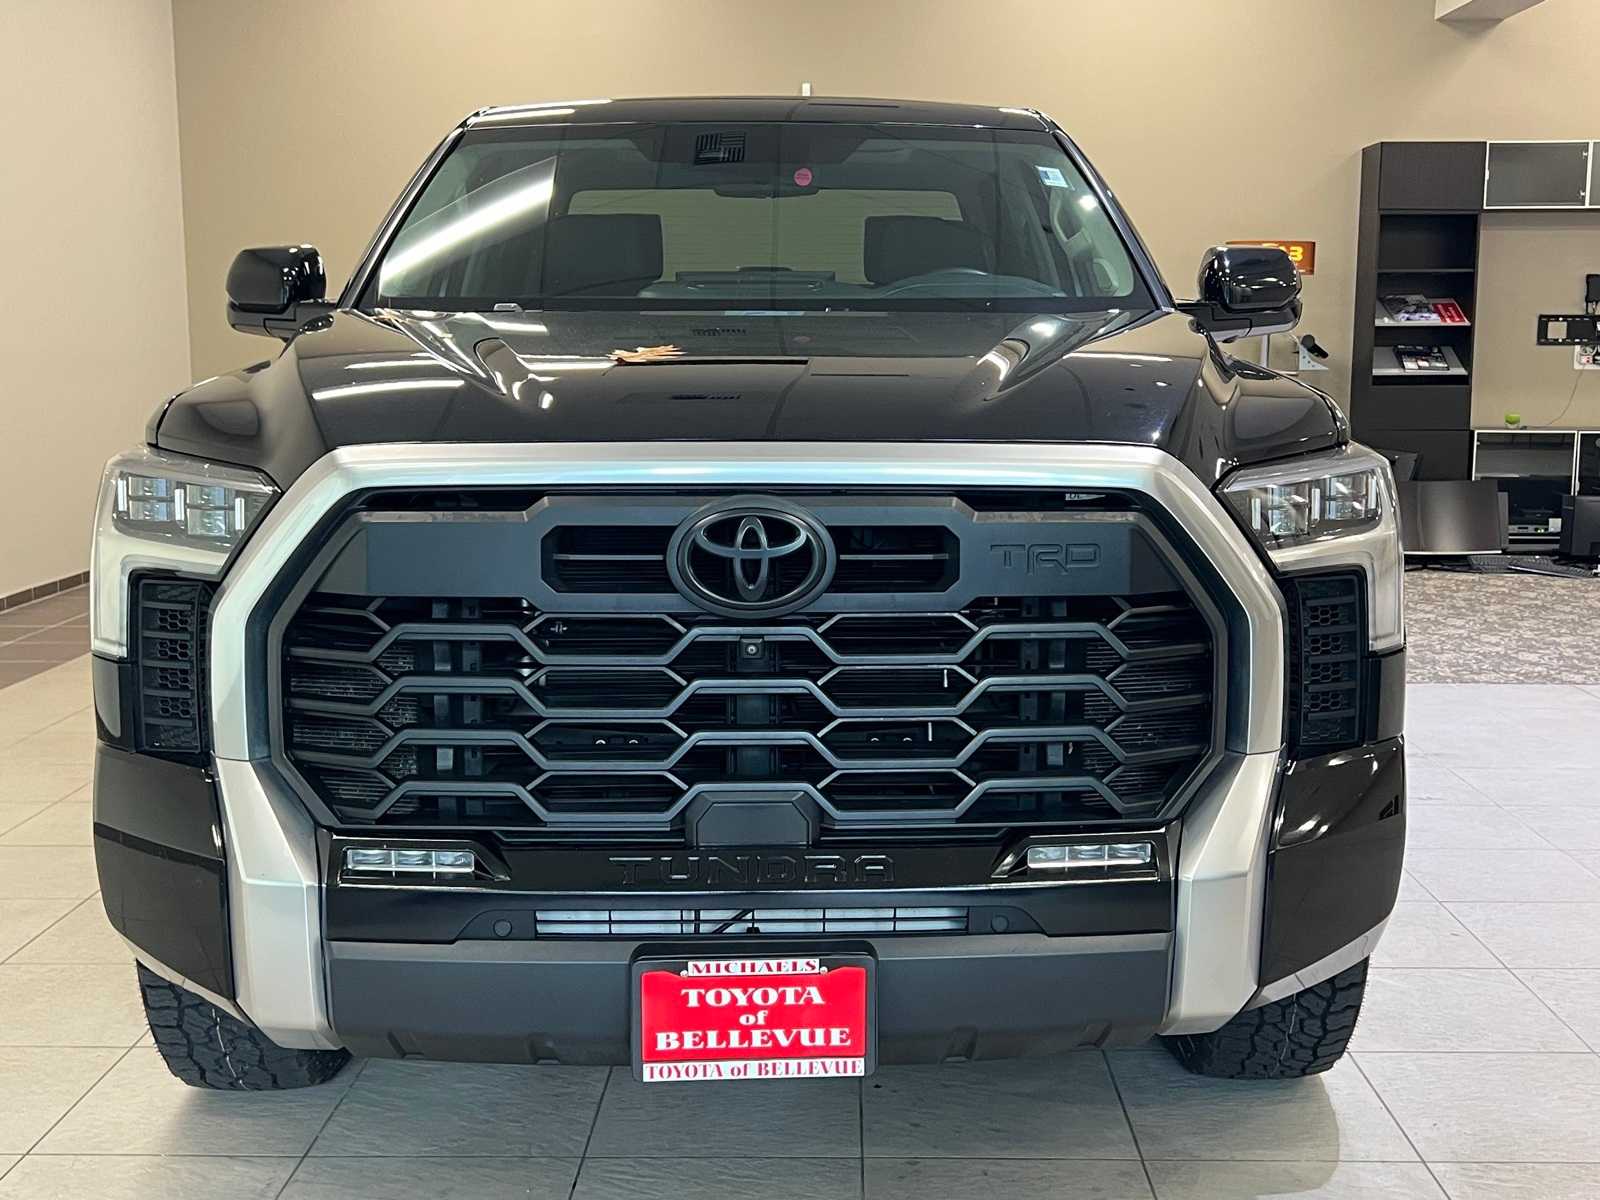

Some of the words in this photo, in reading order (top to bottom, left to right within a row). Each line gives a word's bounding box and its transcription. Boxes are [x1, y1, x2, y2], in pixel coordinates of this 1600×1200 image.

[990, 543, 1101, 576] TRD
[608, 855, 895, 884] TUNDRA
[691, 960, 817, 975] MICHAELS
[680, 986, 825, 1008] TOYOTA
[739, 1010, 768, 1026] of
[655, 1027, 851, 1051] BELLEVUE
[645, 1063, 723, 1080] TOYOTA
[730, 1063, 748, 1077] of
[757, 1060, 863, 1076] BELLEVUE
